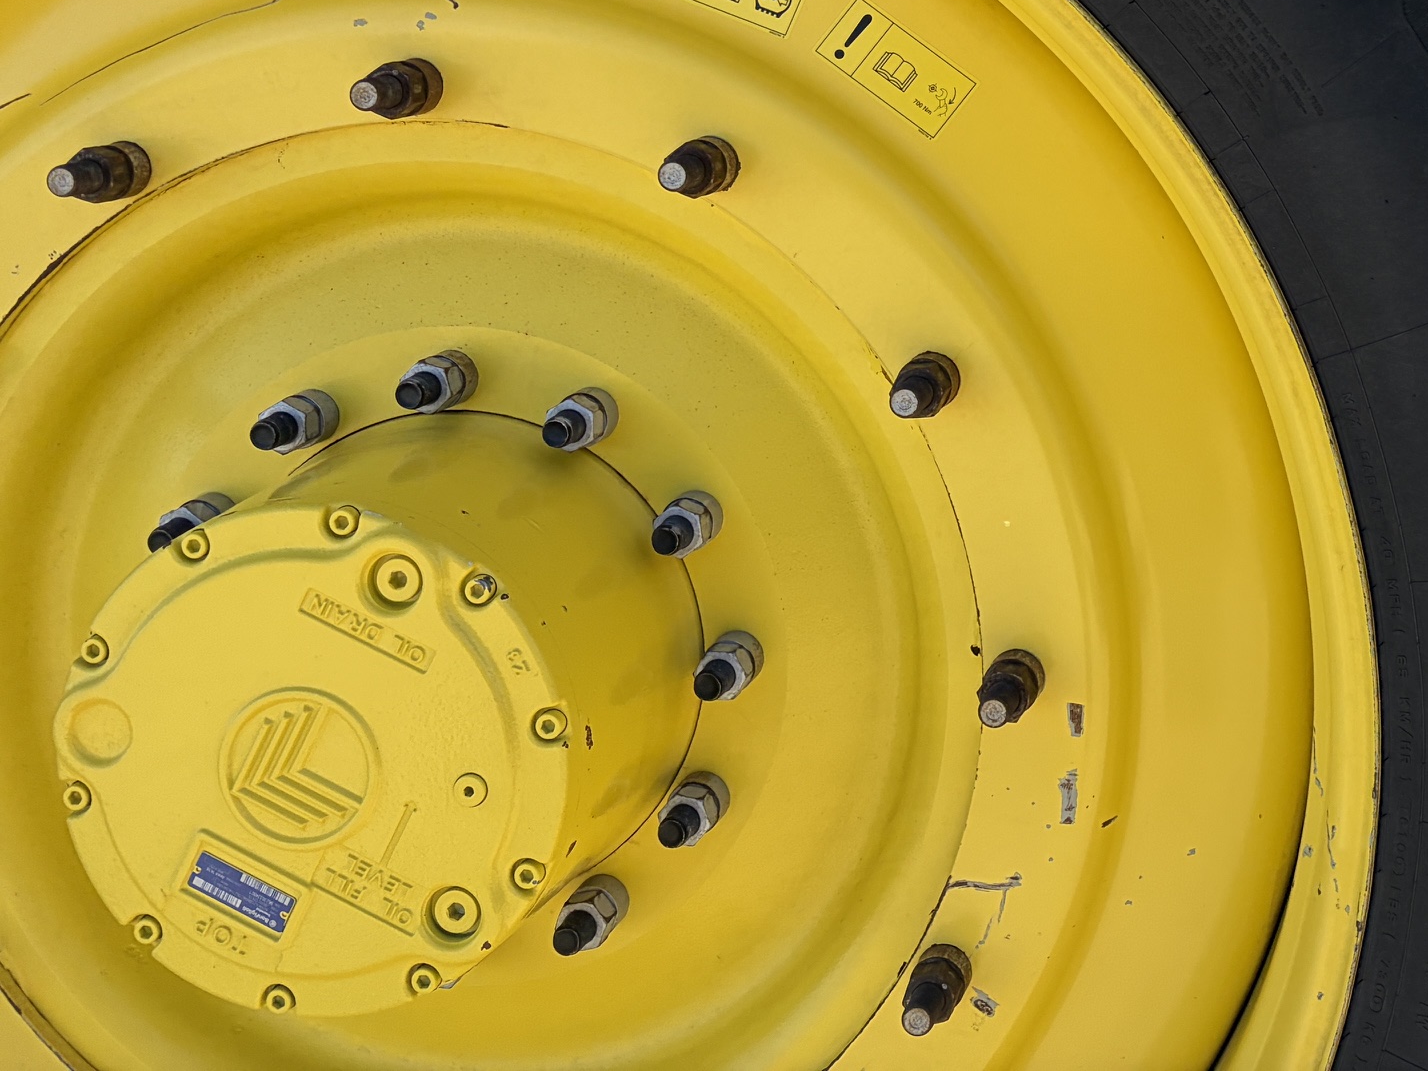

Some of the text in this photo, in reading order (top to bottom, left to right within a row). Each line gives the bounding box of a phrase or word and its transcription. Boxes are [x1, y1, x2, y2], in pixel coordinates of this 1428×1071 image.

[307, 590, 428, 666] OIL DRAIN
[324, 865, 415, 927] OIL FILL
[346, 851, 415, 893] LEVEL
[195, 917, 247, 956] TOP
